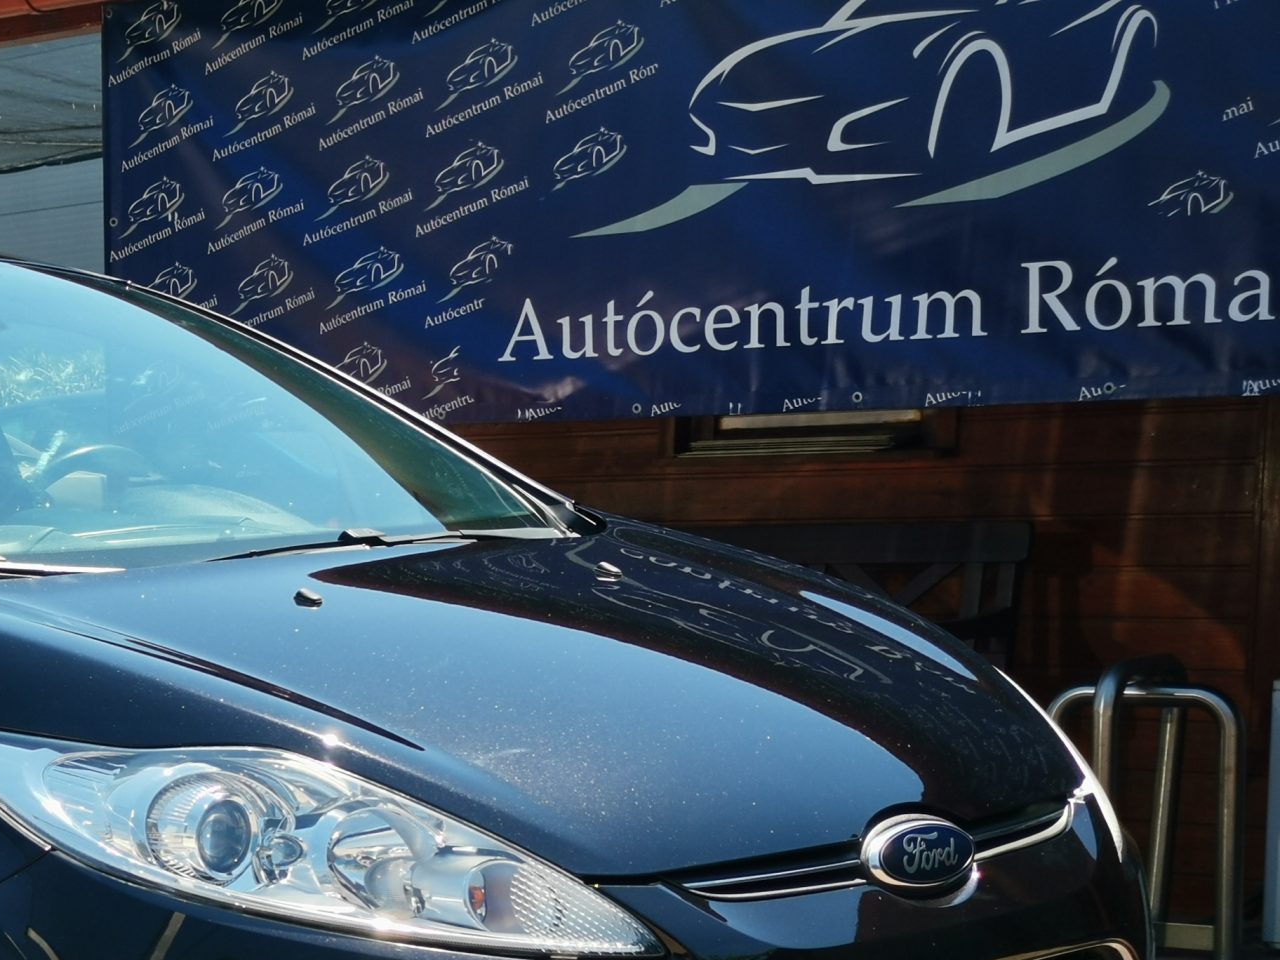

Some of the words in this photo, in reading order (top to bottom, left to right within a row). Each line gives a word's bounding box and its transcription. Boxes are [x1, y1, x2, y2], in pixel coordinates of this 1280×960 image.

[204, 34, 266, 76] Autócentrum
[268, 12, 304, 39] Római
[301, 17, 374, 61] Autócentrum
[411, 0, 488, 44] Autócentrum
[107, 50, 171, 87] Autócentrum
[172, 27, 202, 56] Római
[318, 111, 386, 152] Autócentrum
[387, 87, 424, 116] Római
[425, 95, 501, 138] Autócentrum
[503, 72, 544, 101] Római
[545, 78, 627, 124] Autócentrum
[121, 131, 180, 173] Autócentrum
[180, 115, 214, 139] Római
[212, 122, 283, 162] Autócentrum
[283, 102, 317, 128] Római
[109, 226, 172, 263] Autócentrum
[174, 207, 206, 233] Római
[207, 217, 267, 255] Autócentrum
[269, 199, 305, 224] Római
[302, 208, 377, 247] Autócentrum
[378, 188, 414, 215] Római
[415, 195, 489, 238] Autócentrum
[491, 176, 530, 203] Római
[197, 294, 218, 310] mai
[284, 287, 315, 311] Római
[319, 297, 385, 335] Autócentrum
[387, 280, 427, 305] Római
[498, 285, 987, 362] Autócentrum
[1021, 256, 1276, 335] Róma
[902, 831, 959, 875] Ford
